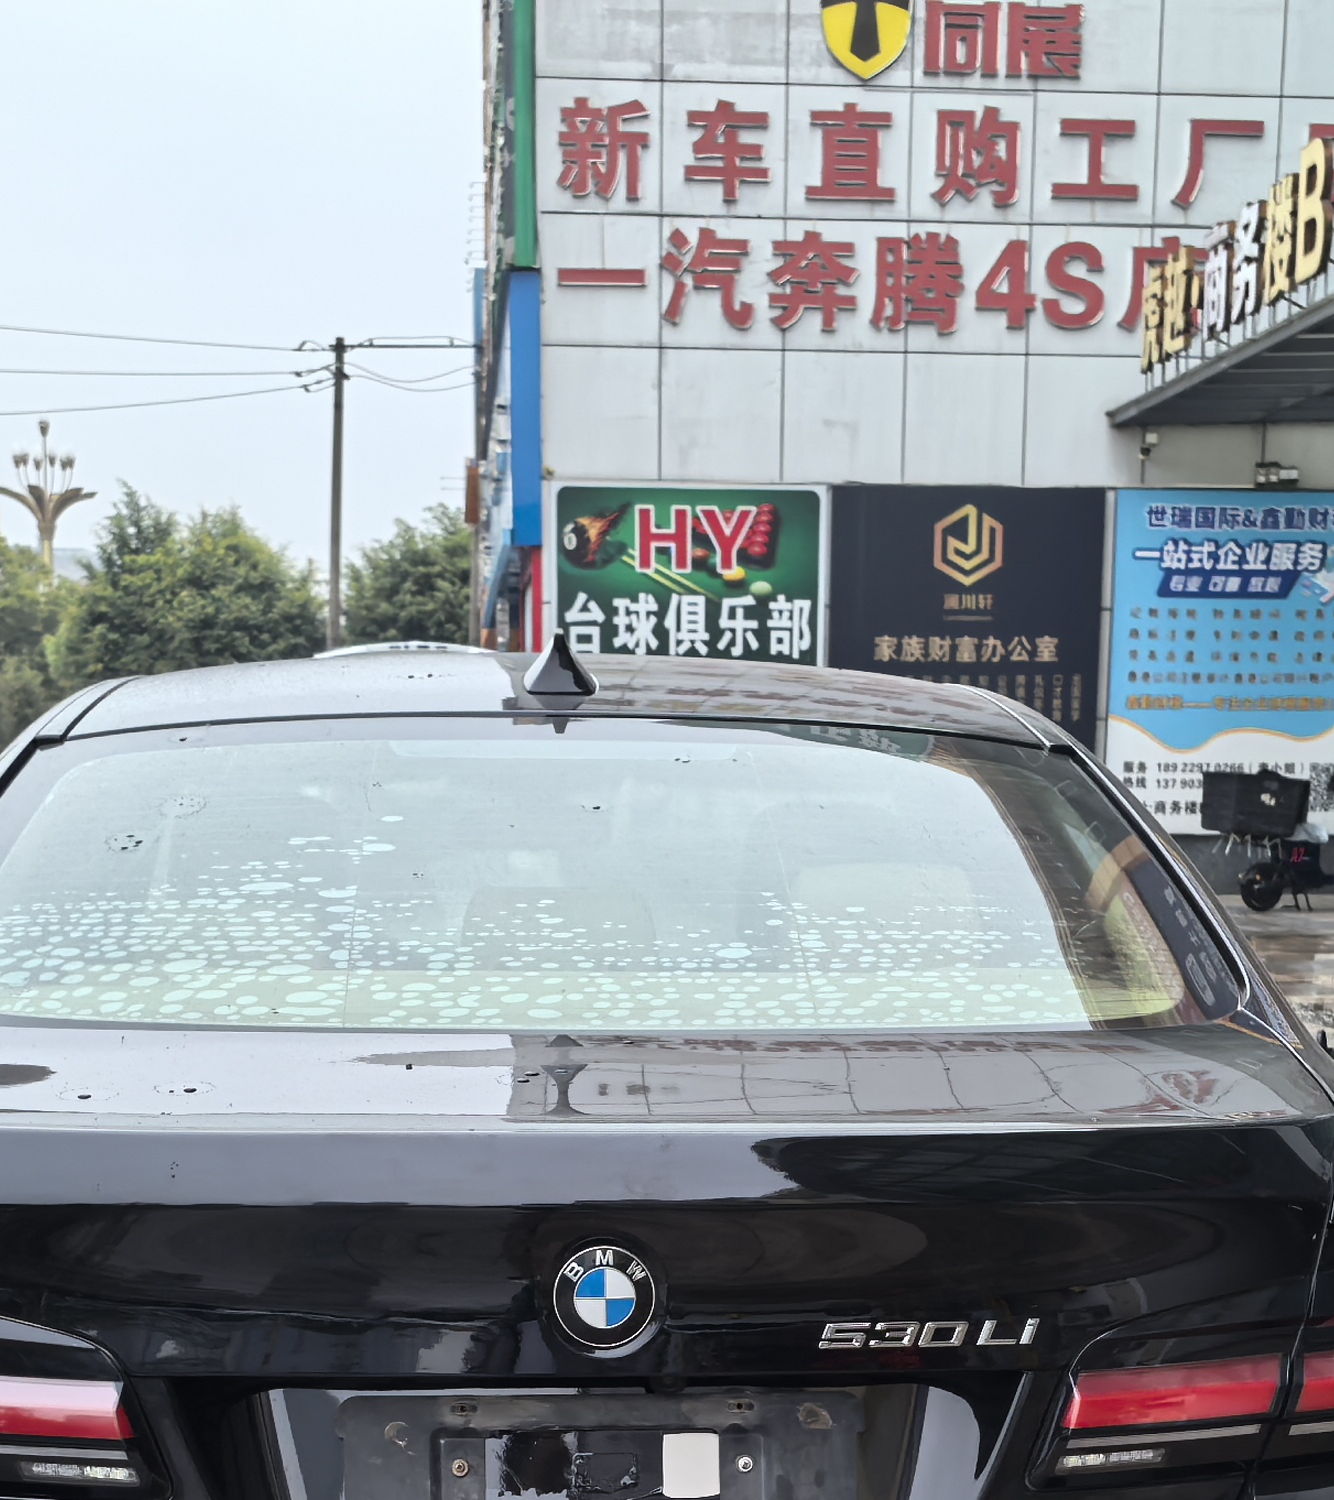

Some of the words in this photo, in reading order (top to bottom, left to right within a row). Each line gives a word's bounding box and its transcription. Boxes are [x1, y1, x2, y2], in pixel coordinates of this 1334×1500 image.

[634, 504, 757, 574] HY
[1134, 539, 1325, 572] 一站式企业服务
[564, 591, 812, 659] 台球俱乐部
[873, 634, 1059, 663] 家族财富办公室
[563, 1249, 647, 1283] BMW
[818, 1317, 1041, 1350] 530Li
